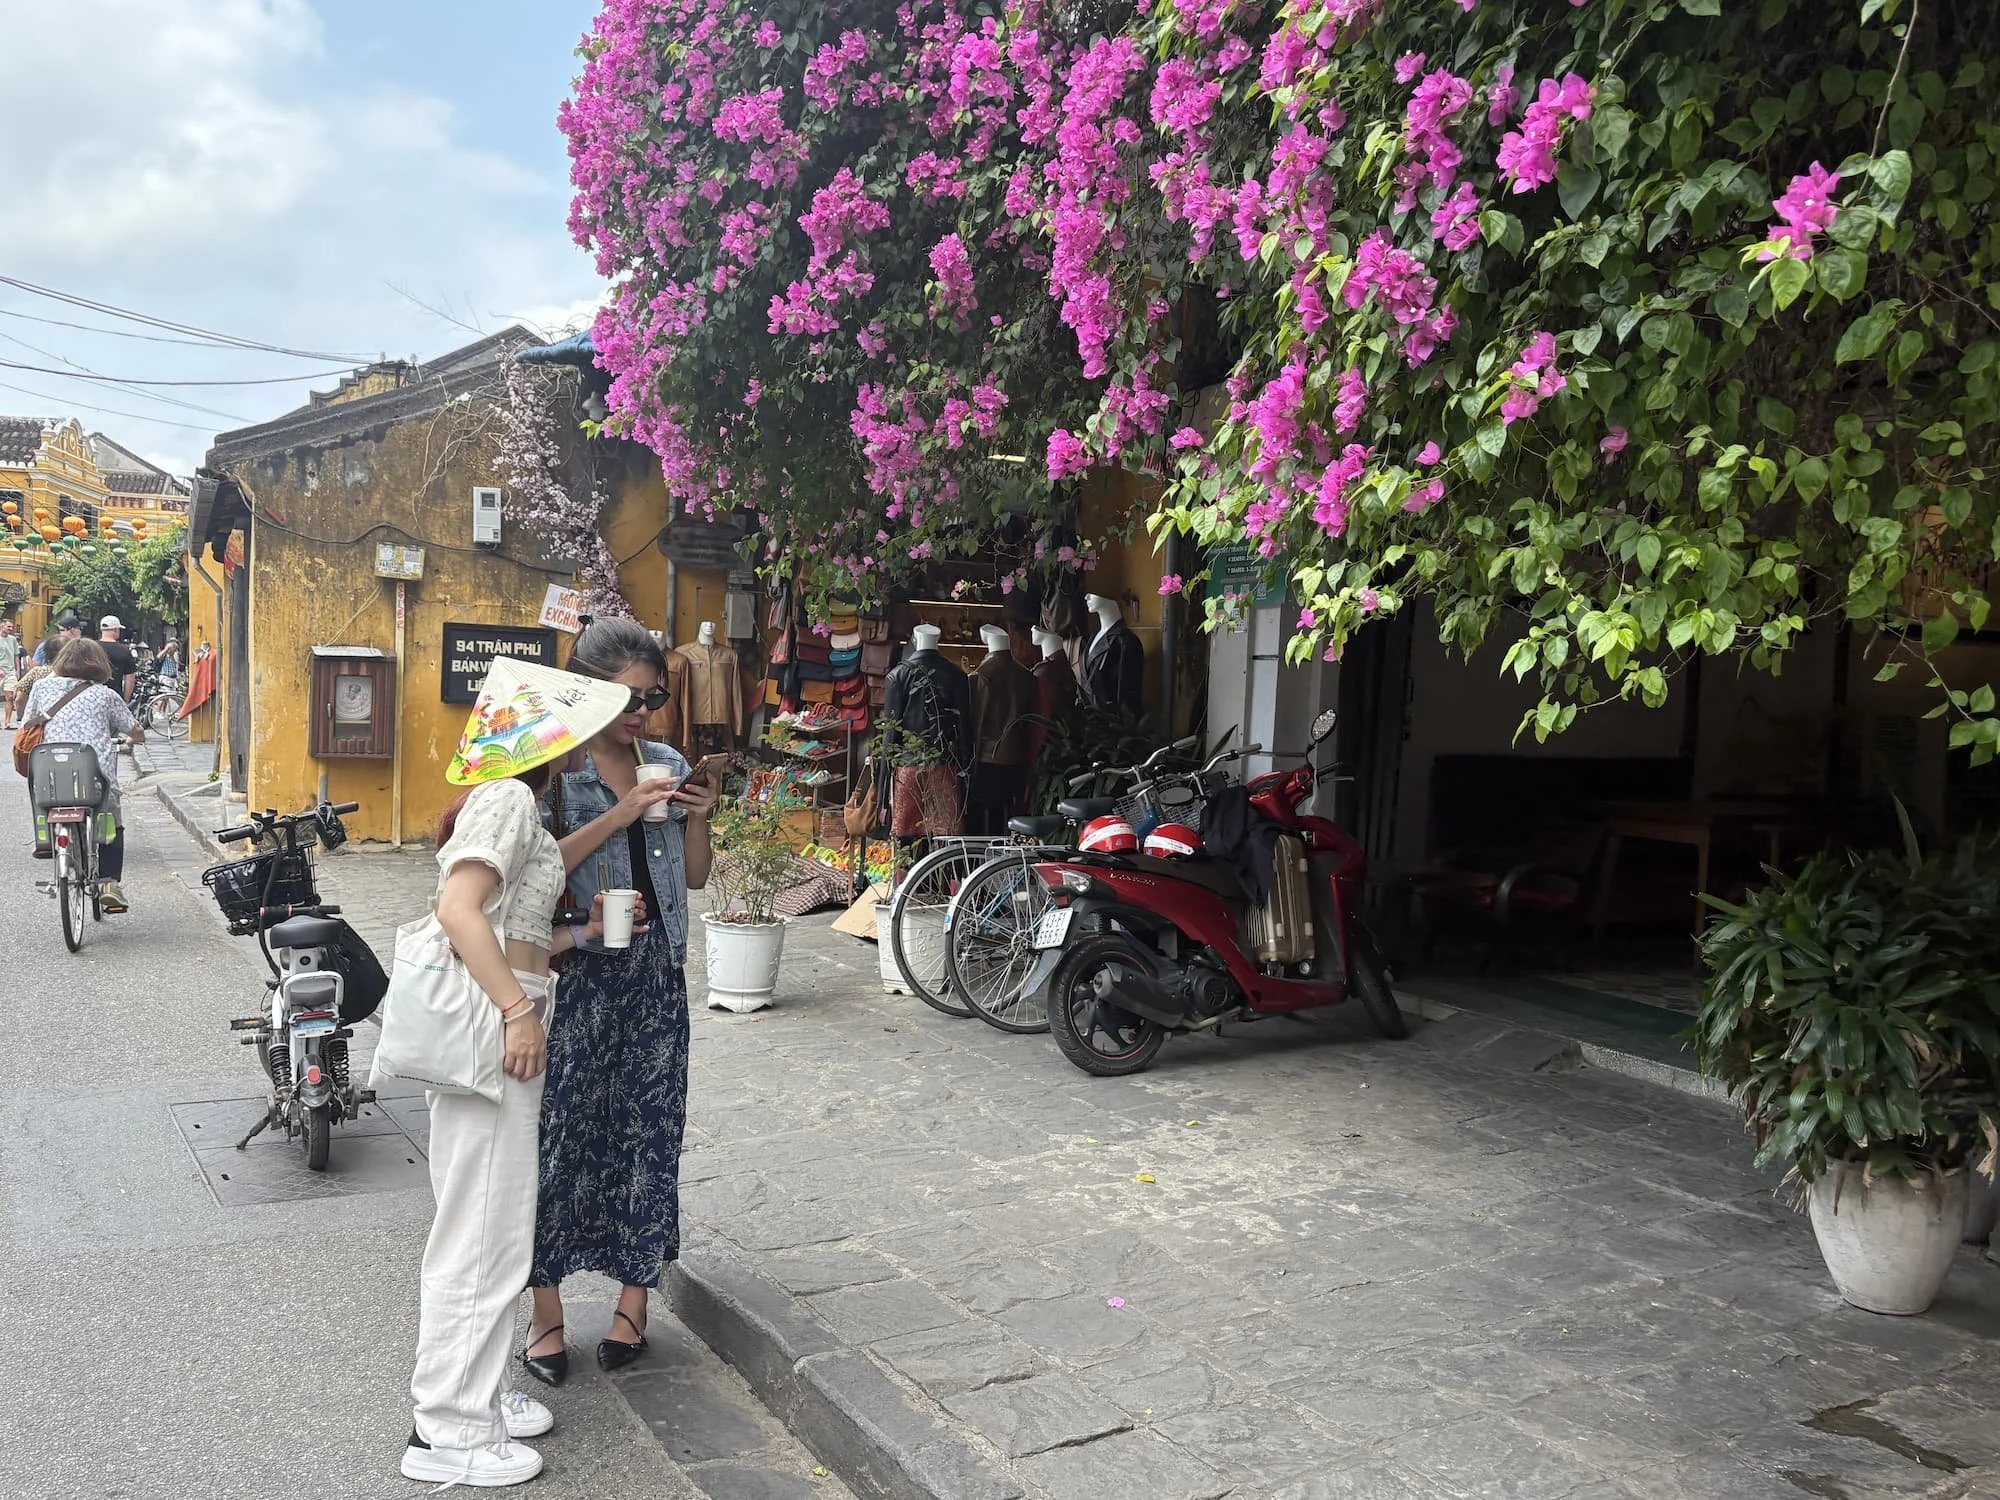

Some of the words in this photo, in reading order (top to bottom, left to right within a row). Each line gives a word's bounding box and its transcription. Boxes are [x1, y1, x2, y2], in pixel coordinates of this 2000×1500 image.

[558, 592, 590, 613] MONY
[545, 607, 582, 630] EXCHAN
[513, 641, 542, 656] PHÚ
[451, 656, 479, 673] BÁN
